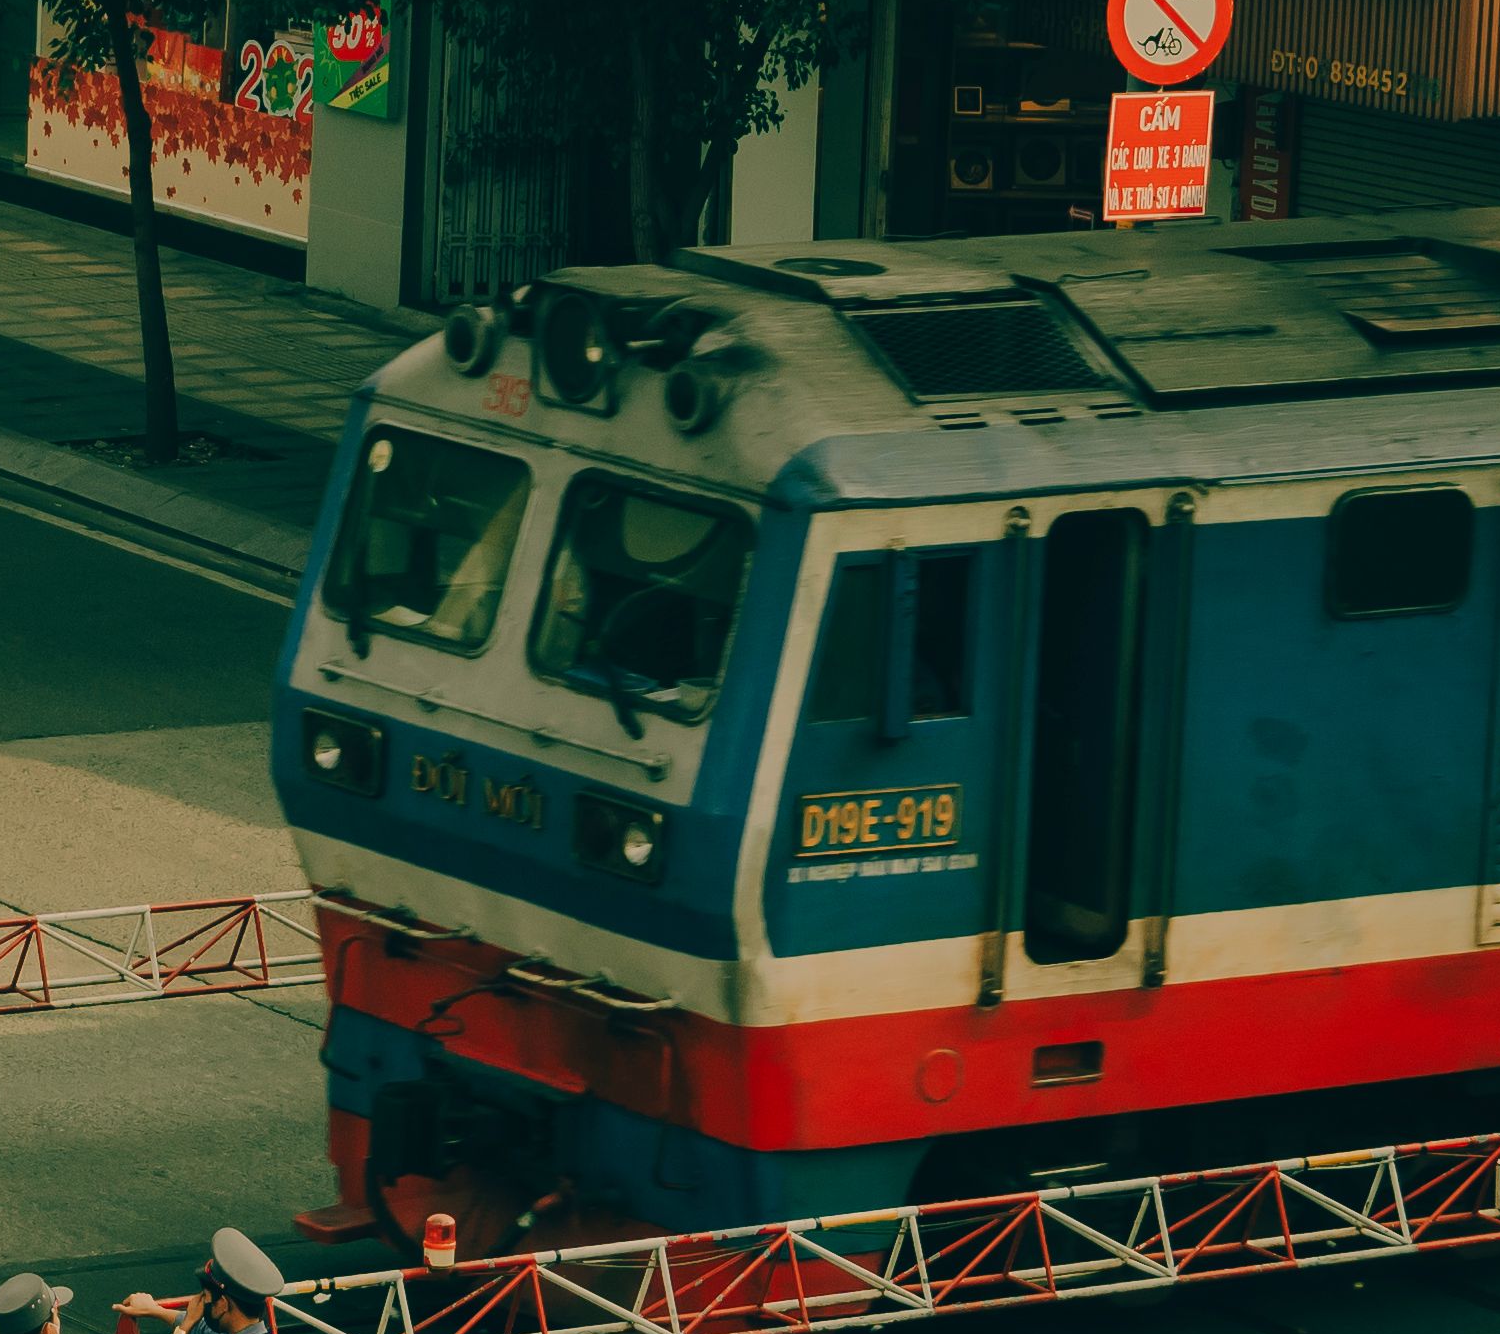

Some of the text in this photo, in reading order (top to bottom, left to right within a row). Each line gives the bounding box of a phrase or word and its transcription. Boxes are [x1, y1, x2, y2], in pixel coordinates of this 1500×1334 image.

[363, 71, 383, 91] SALE
[1139, 97, 1182, 133] CẤM
[1111, 139, 1208, 173] CÁC LOẠI XE 3 BÁNH
[1120, 187, 1134, 211] XE
[1135, 182, 1154, 210] THÔ
[1170, 186, 1178, 209] 4
[1180, 179, 1206, 209] BÁNH
[801, 793, 955, 849] D19E-919
